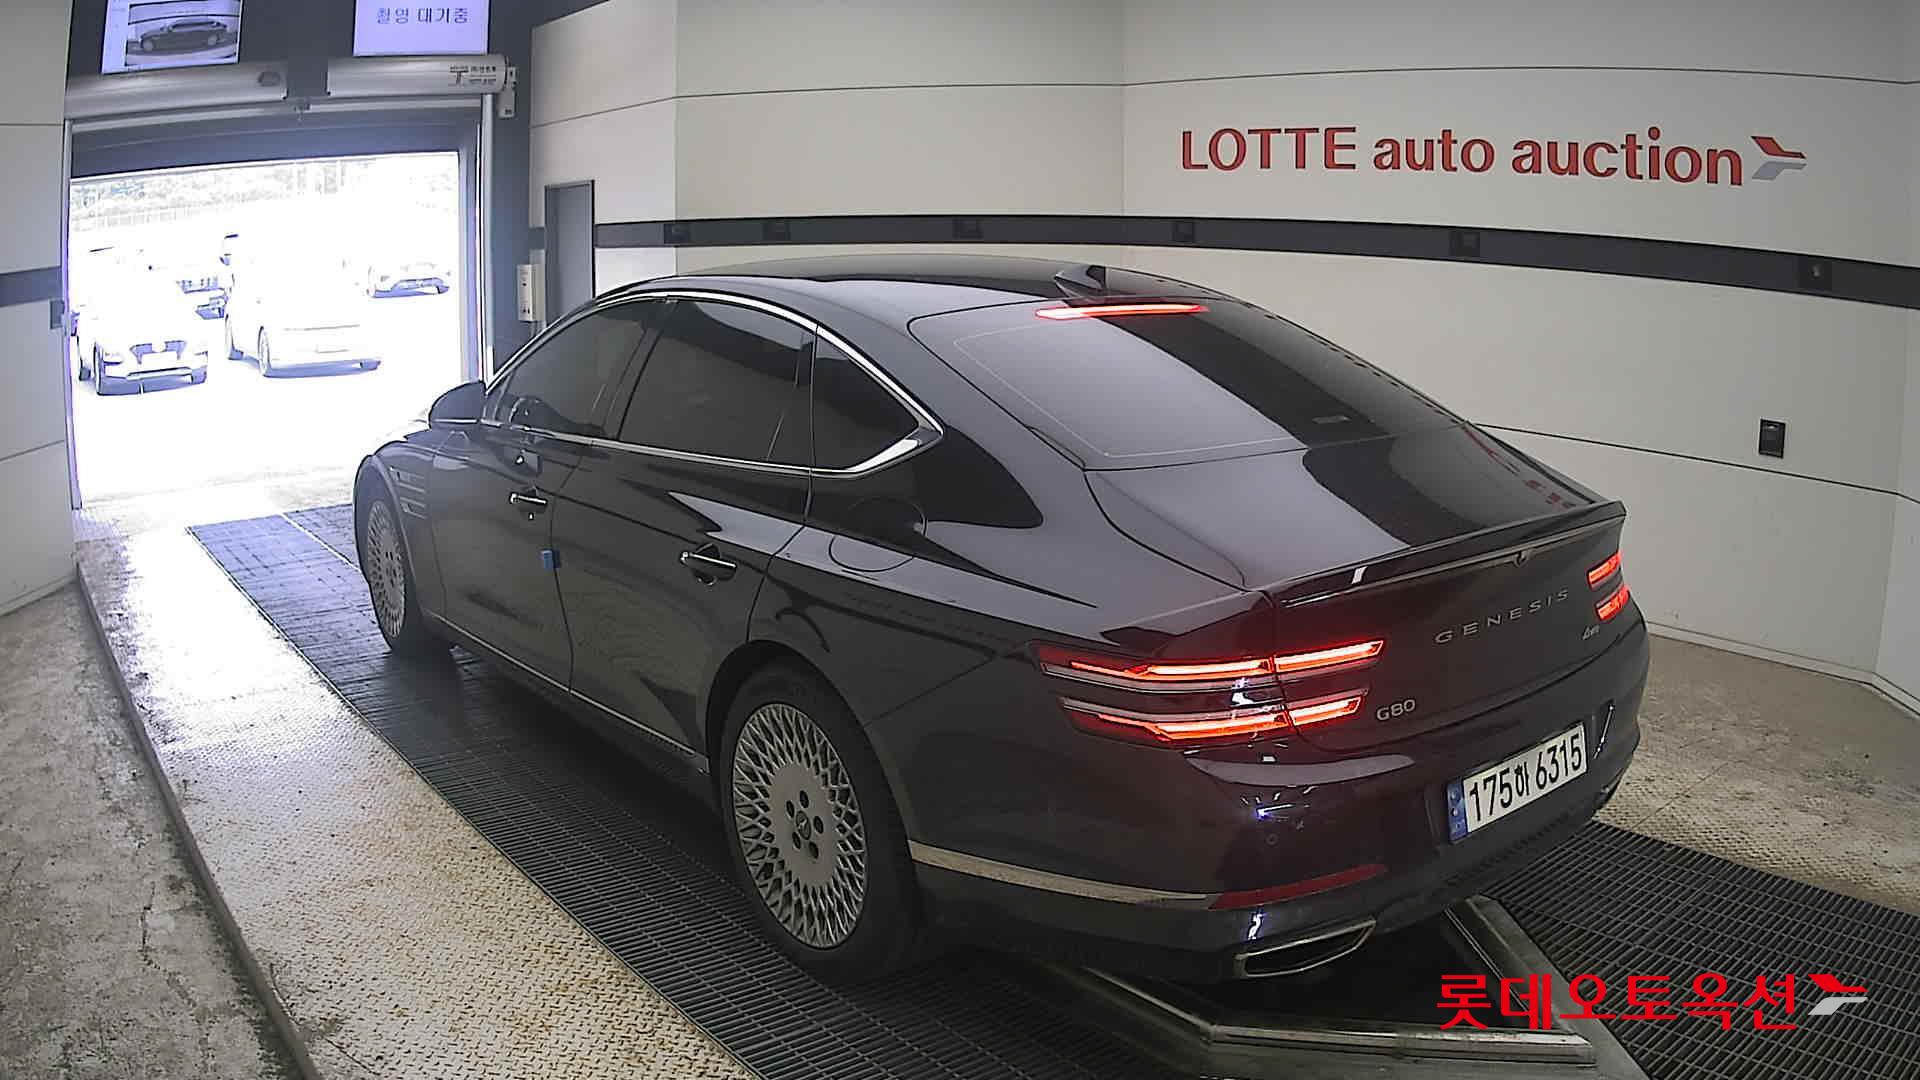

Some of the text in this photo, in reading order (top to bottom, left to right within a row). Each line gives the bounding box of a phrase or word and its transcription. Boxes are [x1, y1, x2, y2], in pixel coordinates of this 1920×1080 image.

[418, 8, 468, 24] 대기중
[1182, 126, 1743, 186] LOTTE auto auction
[1434, 588, 1570, 645] GENESIS
[1376, 699, 1417, 722] G80
[1535, 732, 1582, 791] 6315
